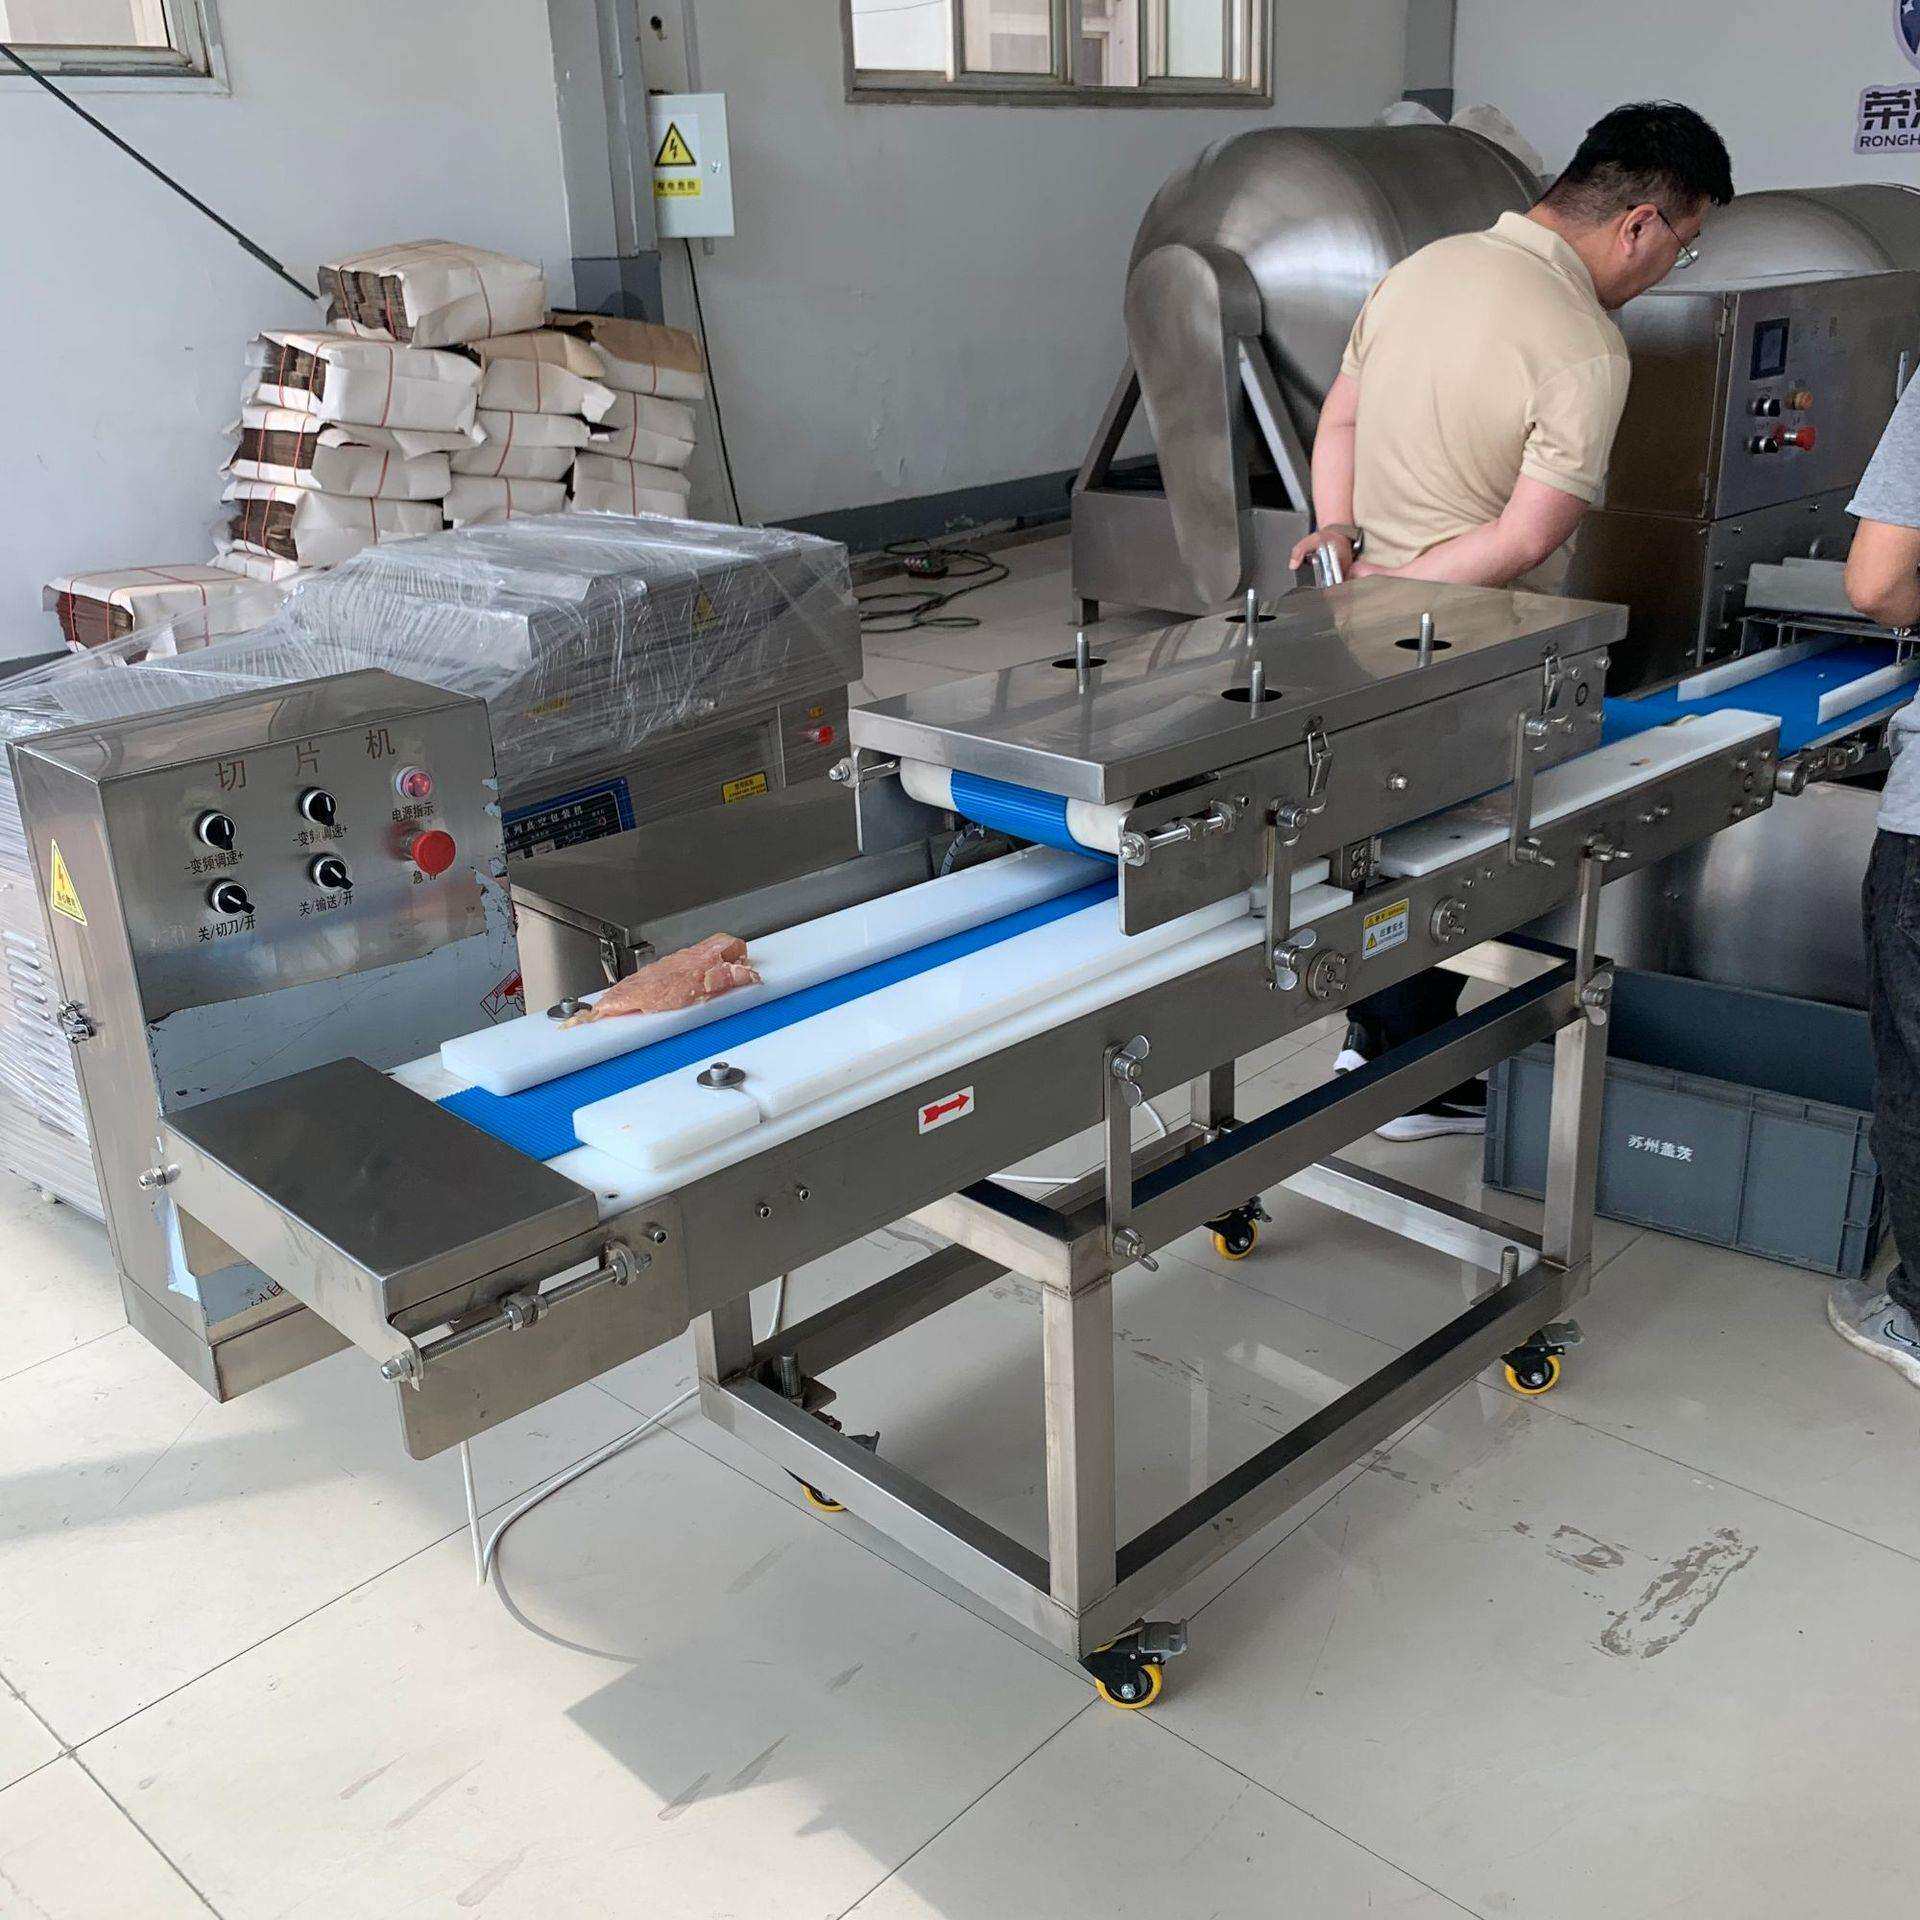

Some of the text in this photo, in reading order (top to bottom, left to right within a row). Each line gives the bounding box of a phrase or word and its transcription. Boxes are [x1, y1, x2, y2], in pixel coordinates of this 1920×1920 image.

[1863, 88, 1920, 131] 荣
[1859, 134, 1920, 148] RONGH
[392, 802, 435, 822] 电源指示
[299, 889, 354, 917] 关/输送/开
[198, 913, 257, 943] 关/切刀/开
